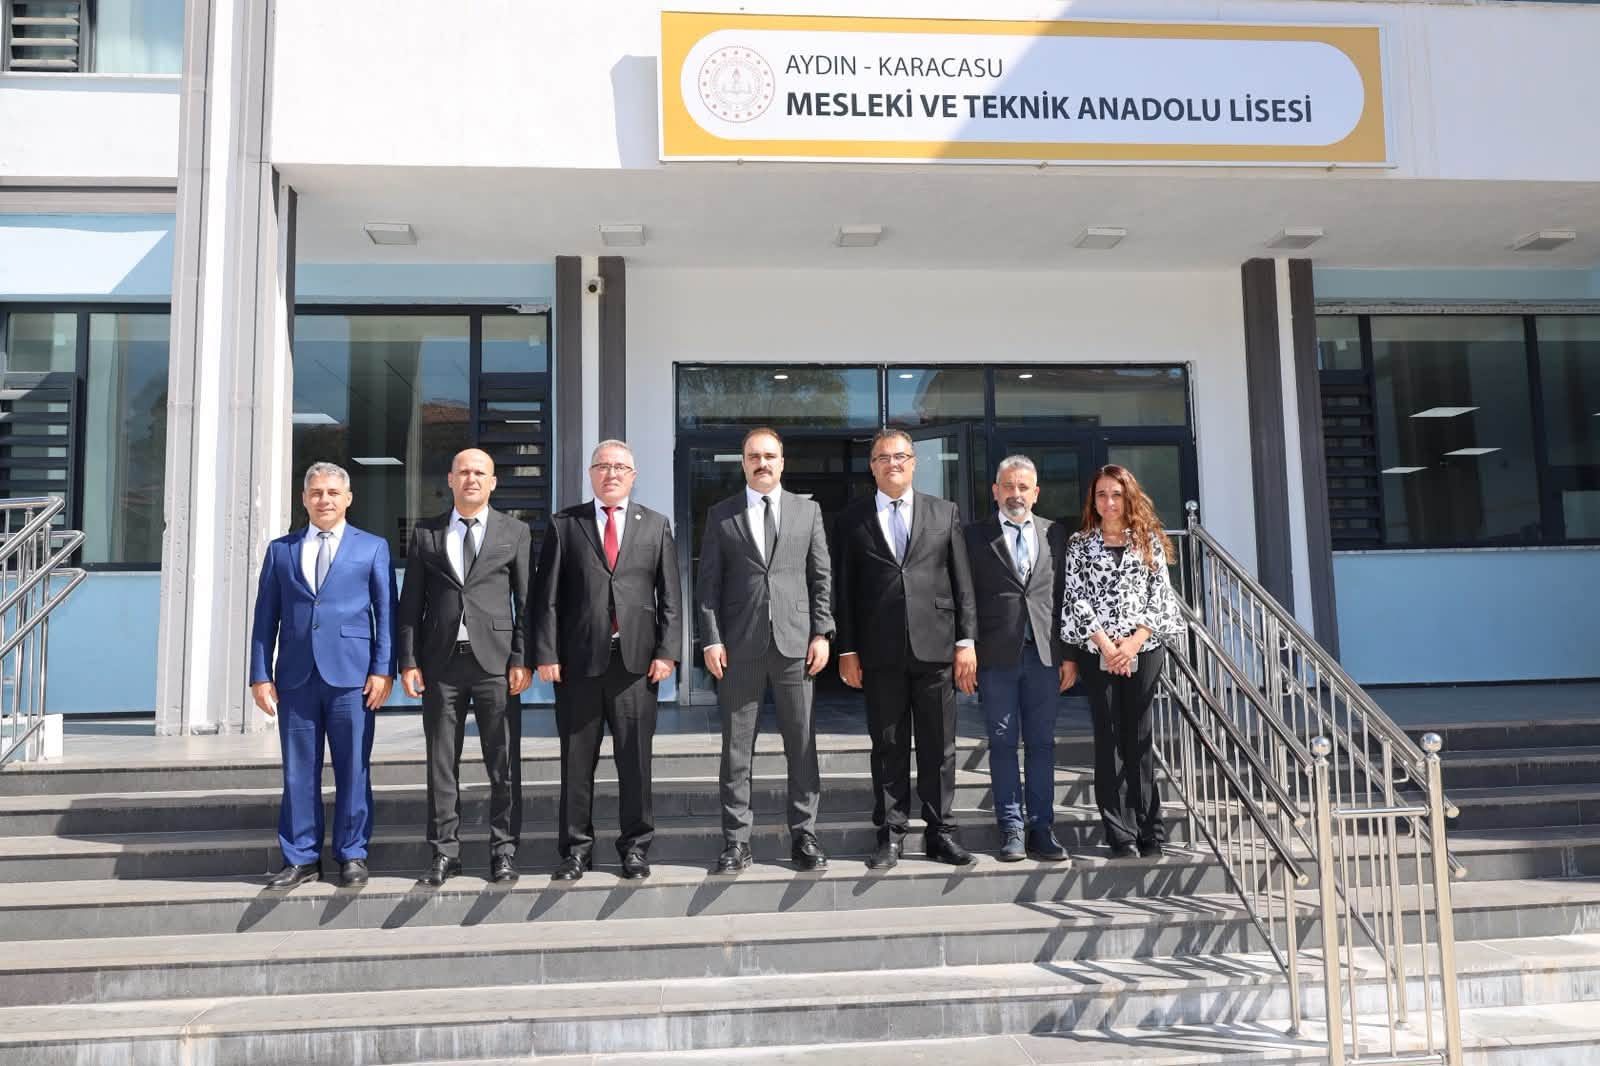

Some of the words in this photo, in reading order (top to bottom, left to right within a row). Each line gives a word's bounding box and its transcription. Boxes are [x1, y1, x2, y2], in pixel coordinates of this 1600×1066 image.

[785, 55, 857, 75] AYDIN
[878, 56, 1003, 78] KARACASU
[786, 88, 913, 117] MESLEKİ
[919, 94, 958, 118] VE
[963, 90, 1070, 119] TEKNİK
[1077, 96, 1221, 122] ANADOLU
[1229, 93, 1312, 123] LİSESİ
